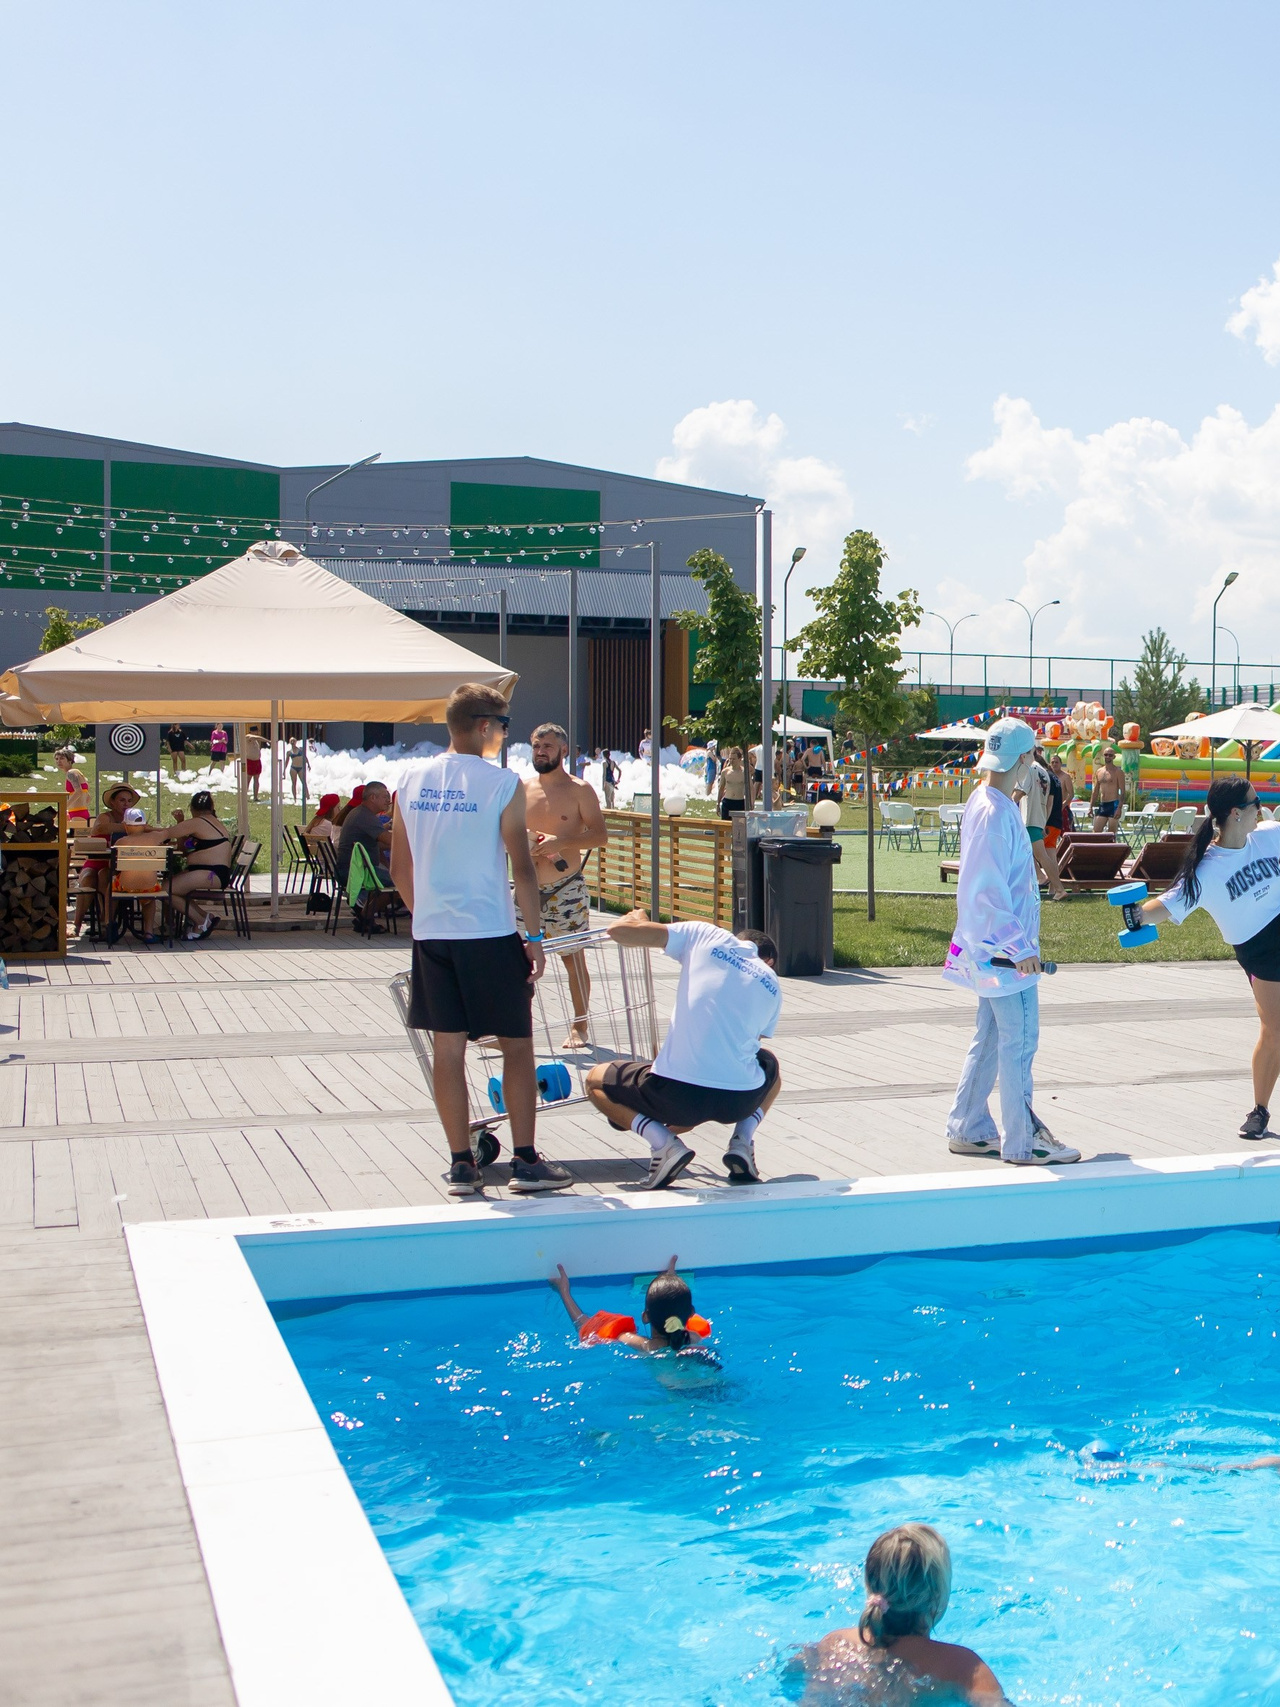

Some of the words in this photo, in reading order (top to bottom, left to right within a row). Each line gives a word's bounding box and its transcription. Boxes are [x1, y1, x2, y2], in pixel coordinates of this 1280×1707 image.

[453, 802, 478, 813] AQUA
[1225, 856, 1280, 902] MOSCOW
[1125, 907, 1134, 929] BECO
[710, 947, 759, 979] ROMANOVO
[760, 977, 779, 997] AQUA
